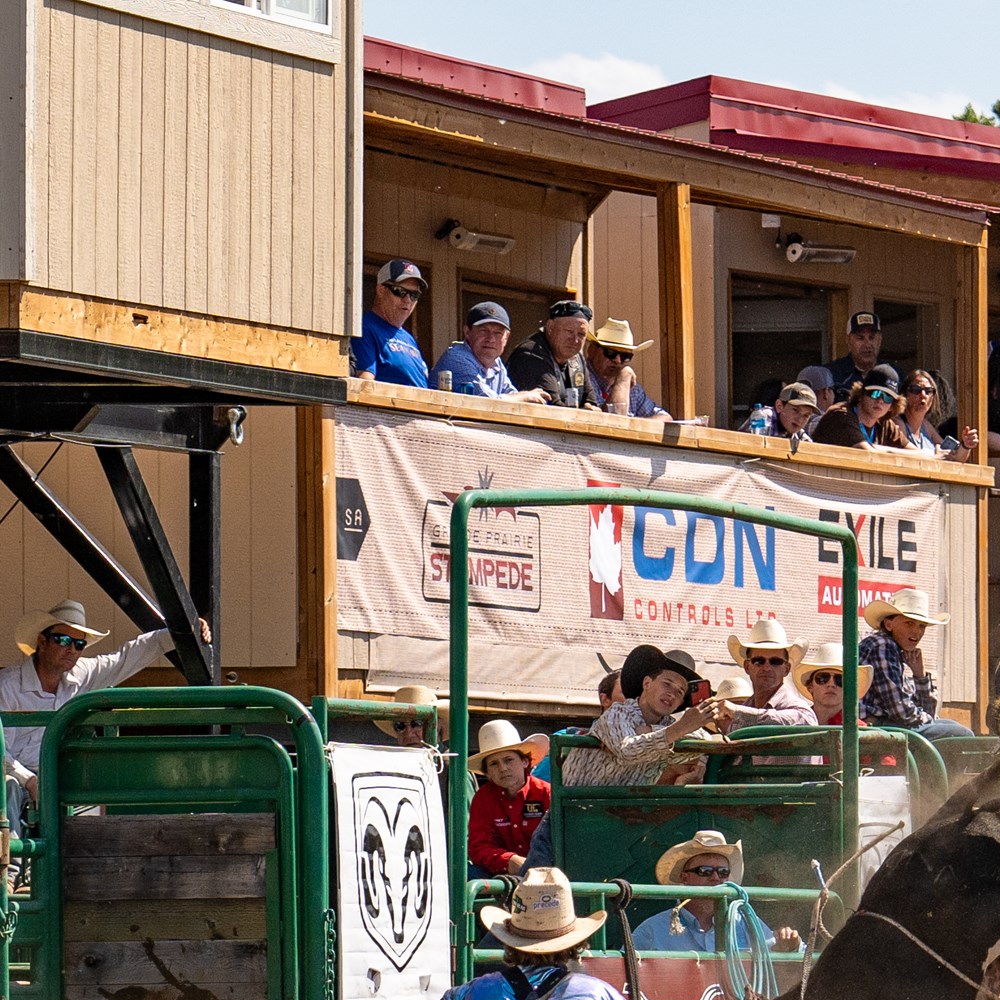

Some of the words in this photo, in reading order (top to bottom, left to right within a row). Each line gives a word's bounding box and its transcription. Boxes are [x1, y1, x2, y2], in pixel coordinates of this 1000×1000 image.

[344, 508, 363, 526] SA
[486, 531, 533, 549] PRAIRIE
[632, 502, 776, 591] CDN
[818, 508, 917, 573] EXILE
[430, 552, 533, 592] STMPEDE
[634, 599, 734, 628] CONTROLS
